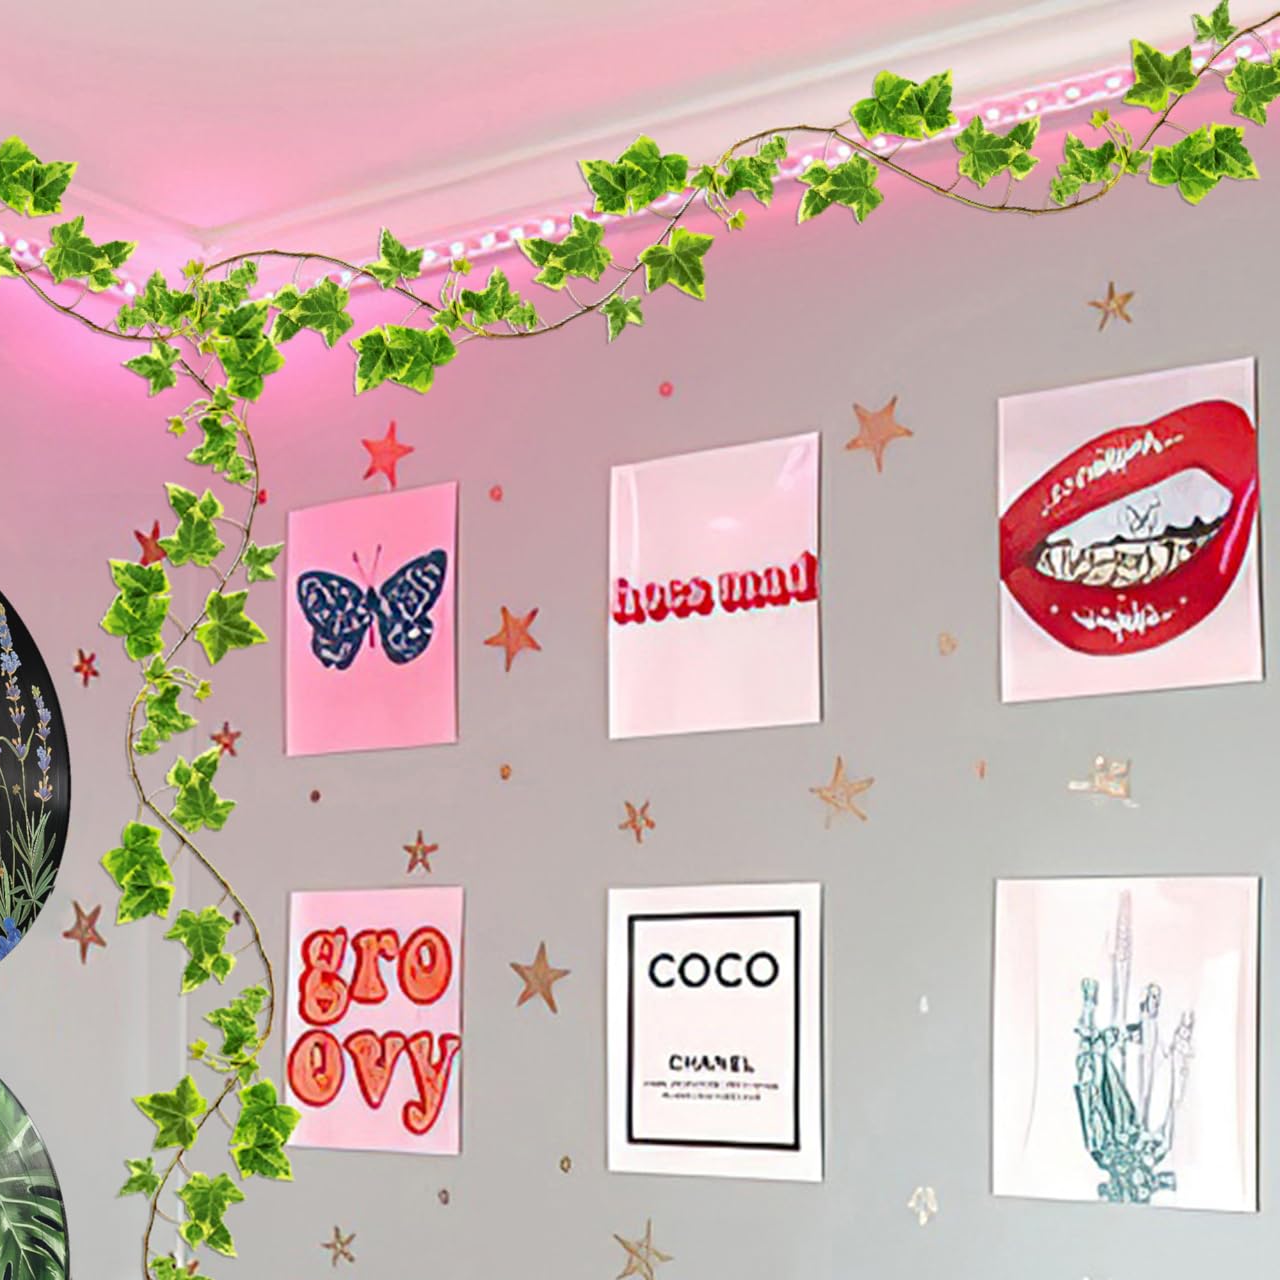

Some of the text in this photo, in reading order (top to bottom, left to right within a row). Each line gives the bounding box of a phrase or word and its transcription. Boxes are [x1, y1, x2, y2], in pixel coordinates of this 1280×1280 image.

[298, 926, 453, 1026] gro
[648, 951, 780, 988] COCO
[287, 1028, 462, 1135] ovy
